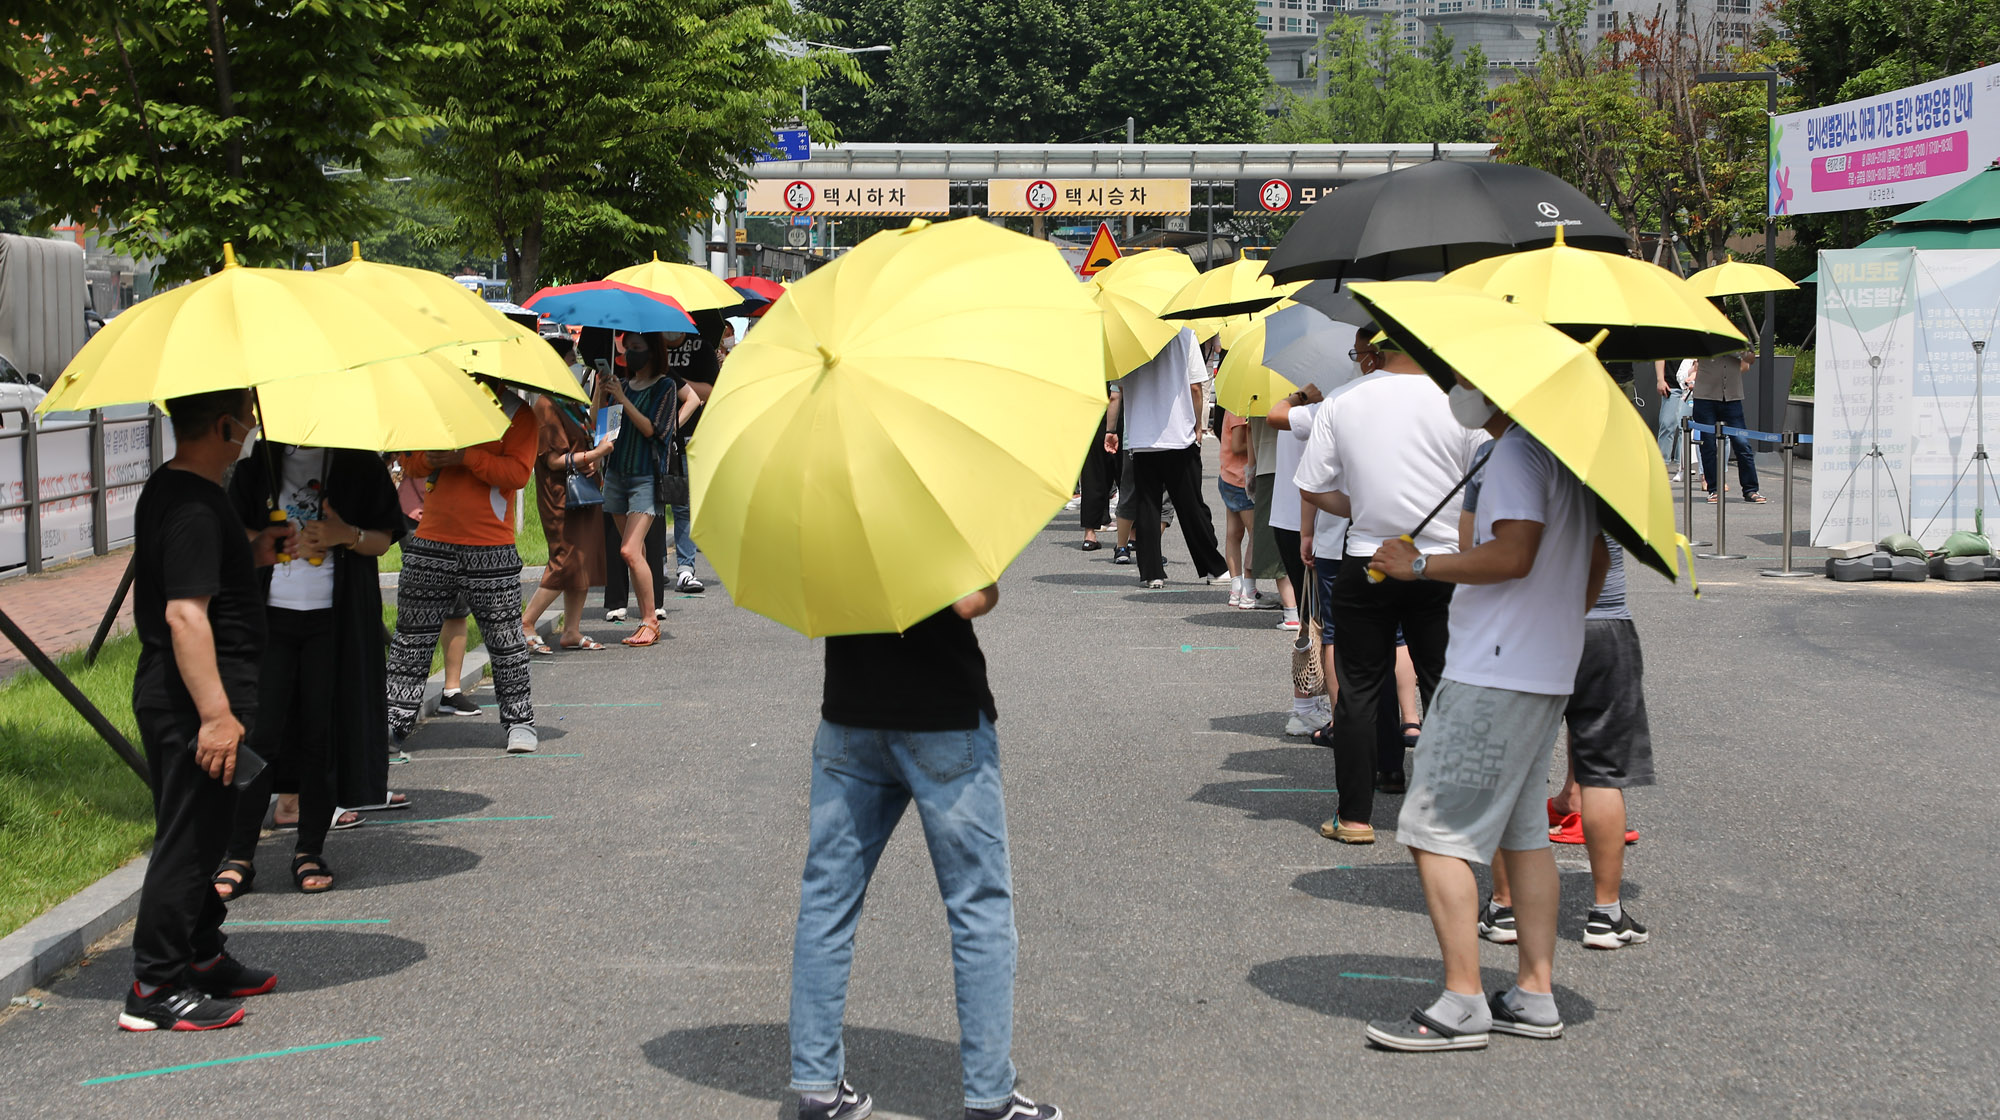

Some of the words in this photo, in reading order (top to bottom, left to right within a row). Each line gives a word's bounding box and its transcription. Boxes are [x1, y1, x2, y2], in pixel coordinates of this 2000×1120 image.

[1807, 111, 1857, 151] 임시선별검사소
[1859, 106, 1875, 141] 아래
[1877, 102, 1894, 138] 기간
[1896, 98, 1913, 136] 동안
[1915, 88, 1951, 132] 연장운영
[1953, 82, 1973, 123] 안내
[823, 188, 906, 207] 택시하차
[1066, 187, 1147, 206] 택시승차
[667, 353, 691, 367] LLS
